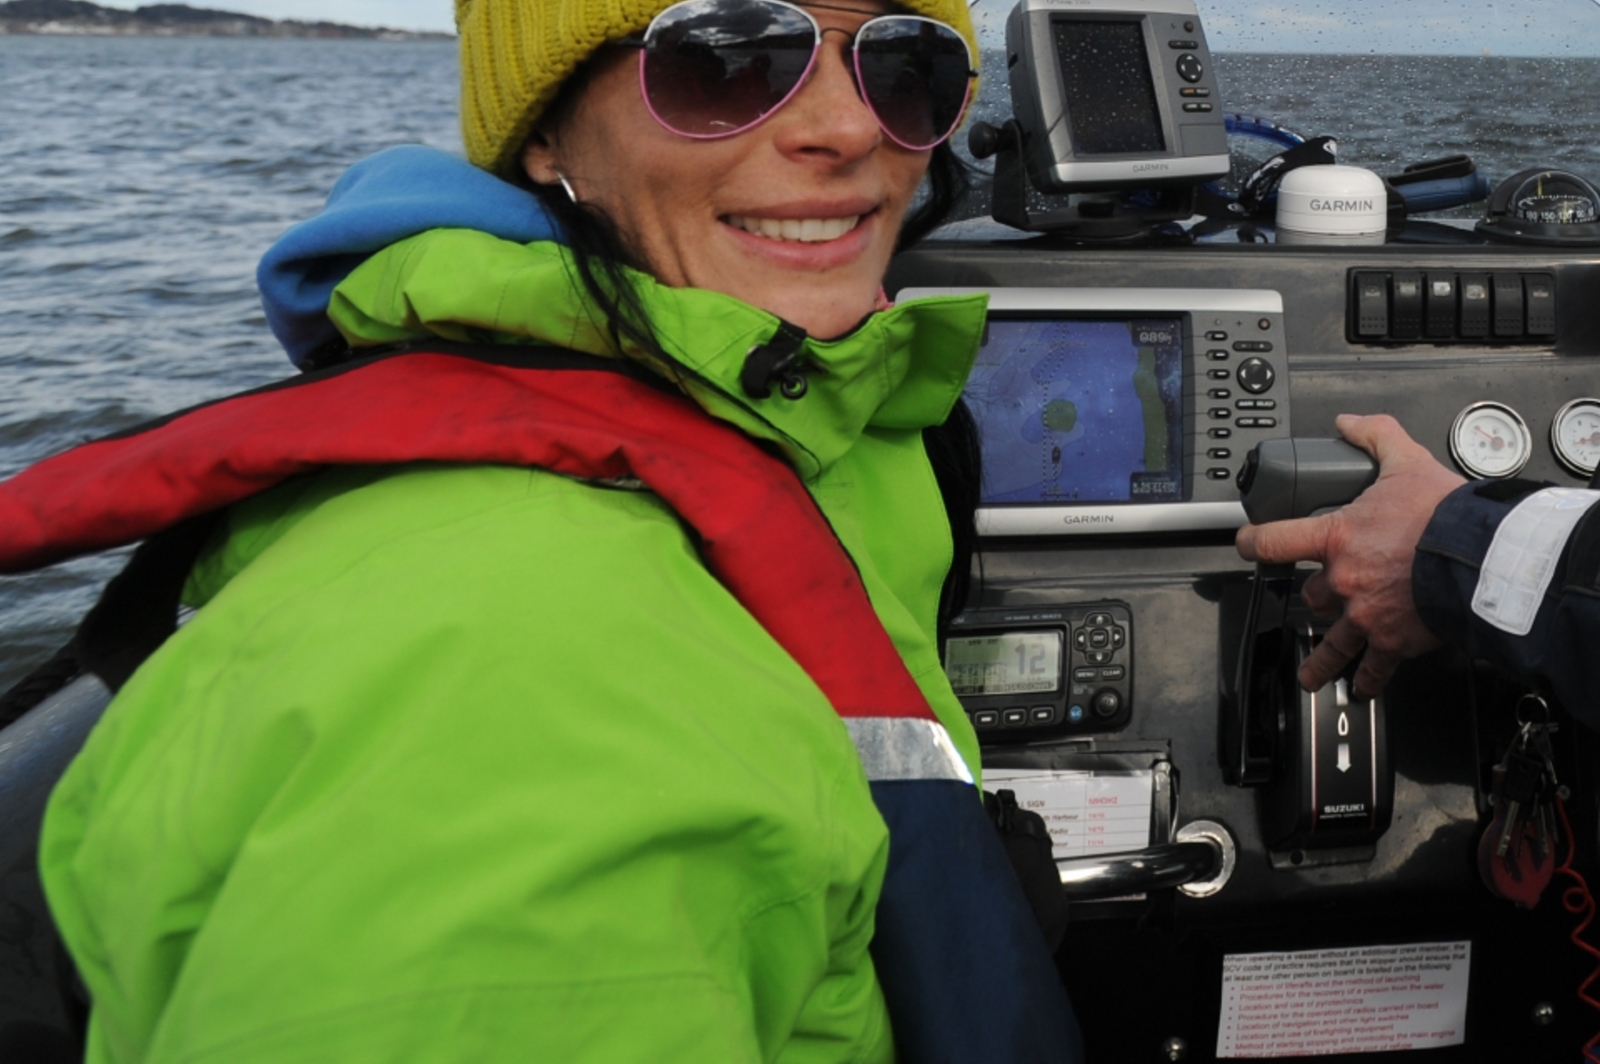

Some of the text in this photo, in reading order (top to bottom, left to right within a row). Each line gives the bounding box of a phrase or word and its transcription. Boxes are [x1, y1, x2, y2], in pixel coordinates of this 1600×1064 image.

[1132, 164, 1169, 173] GARMIN
[1309, 198, 1373, 212] GARMIN
[1063, 515, 1114, 524] GARMIN
[1014, 643, 1046, 676] 12
[1324, 803, 1364, 814] SUZUKI
[1274, 962, 1304, 971] practice
[1307, 961, 1337, 970] requires
[1370, 957, 1396, 965] skipper
[1385, 974, 1420, 983] launching
[1313, 989, 1345, 998] recovery
[1315, 998, 1363, 1008] pyrotechnics
[1307, 1010, 1342, 1018] operation
[1282, 1021, 1320, 1029] navigation
[1354, 1024, 1394, 1033] equipment
[1356, 1034, 1395, 1042] controlling
[1430, 1030, 1455, 1038] engine
